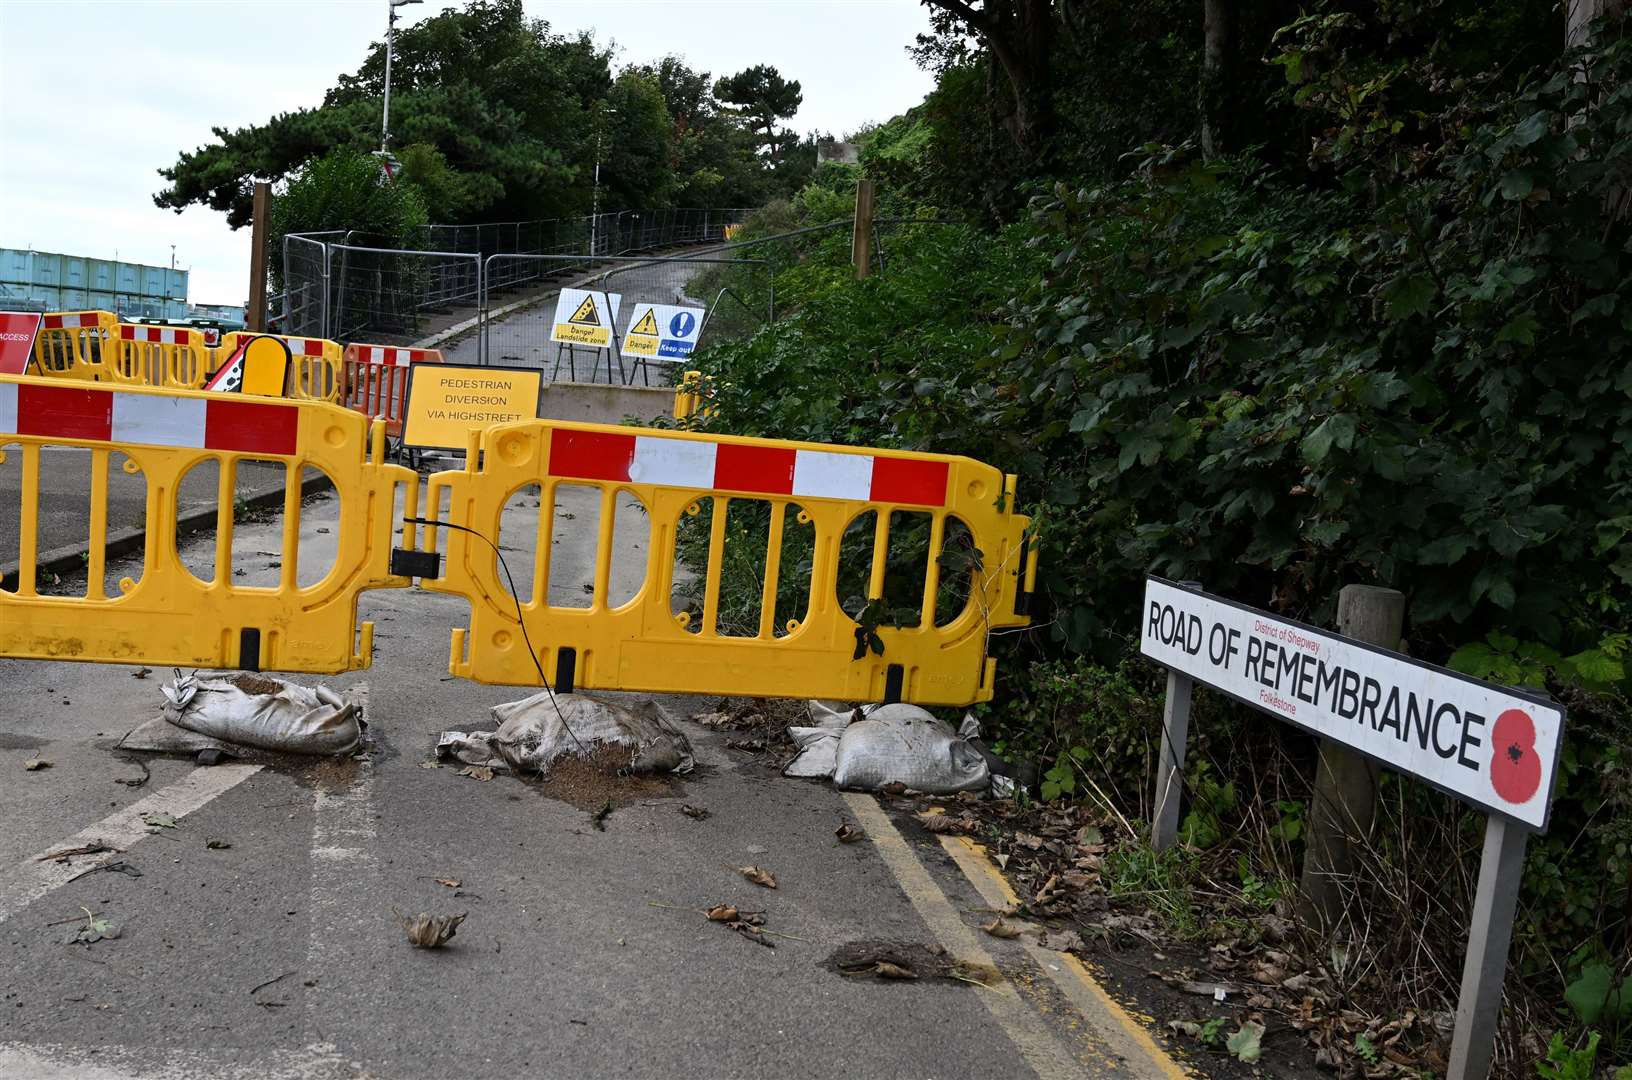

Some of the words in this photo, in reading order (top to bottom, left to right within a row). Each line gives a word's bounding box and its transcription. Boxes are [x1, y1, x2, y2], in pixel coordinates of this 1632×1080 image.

[590, 337, 606, 345] zone
[661, 344, 677, 354] Keep
[679, 345, 693, 354] out
[440, 378, 512, 390] PEDESTRIAN
[445, 394, 507, 406] DIVERSION
[427, 410, 445, 419] VIA
[448, 411, 521, 422] HIGHSTREET
[1255, 620, 1278, 638] District
[1279, 629, 1288, 640] of
[1288, 631, 1321, 655] Shepway
[1148, 600, 1203, 656] ROAD
[1209, 622, 1241, 669] OF
[1245, 636, 1486, 772] REMEMBRANCE
[1260, 689, 1297, 715] Folkestone
